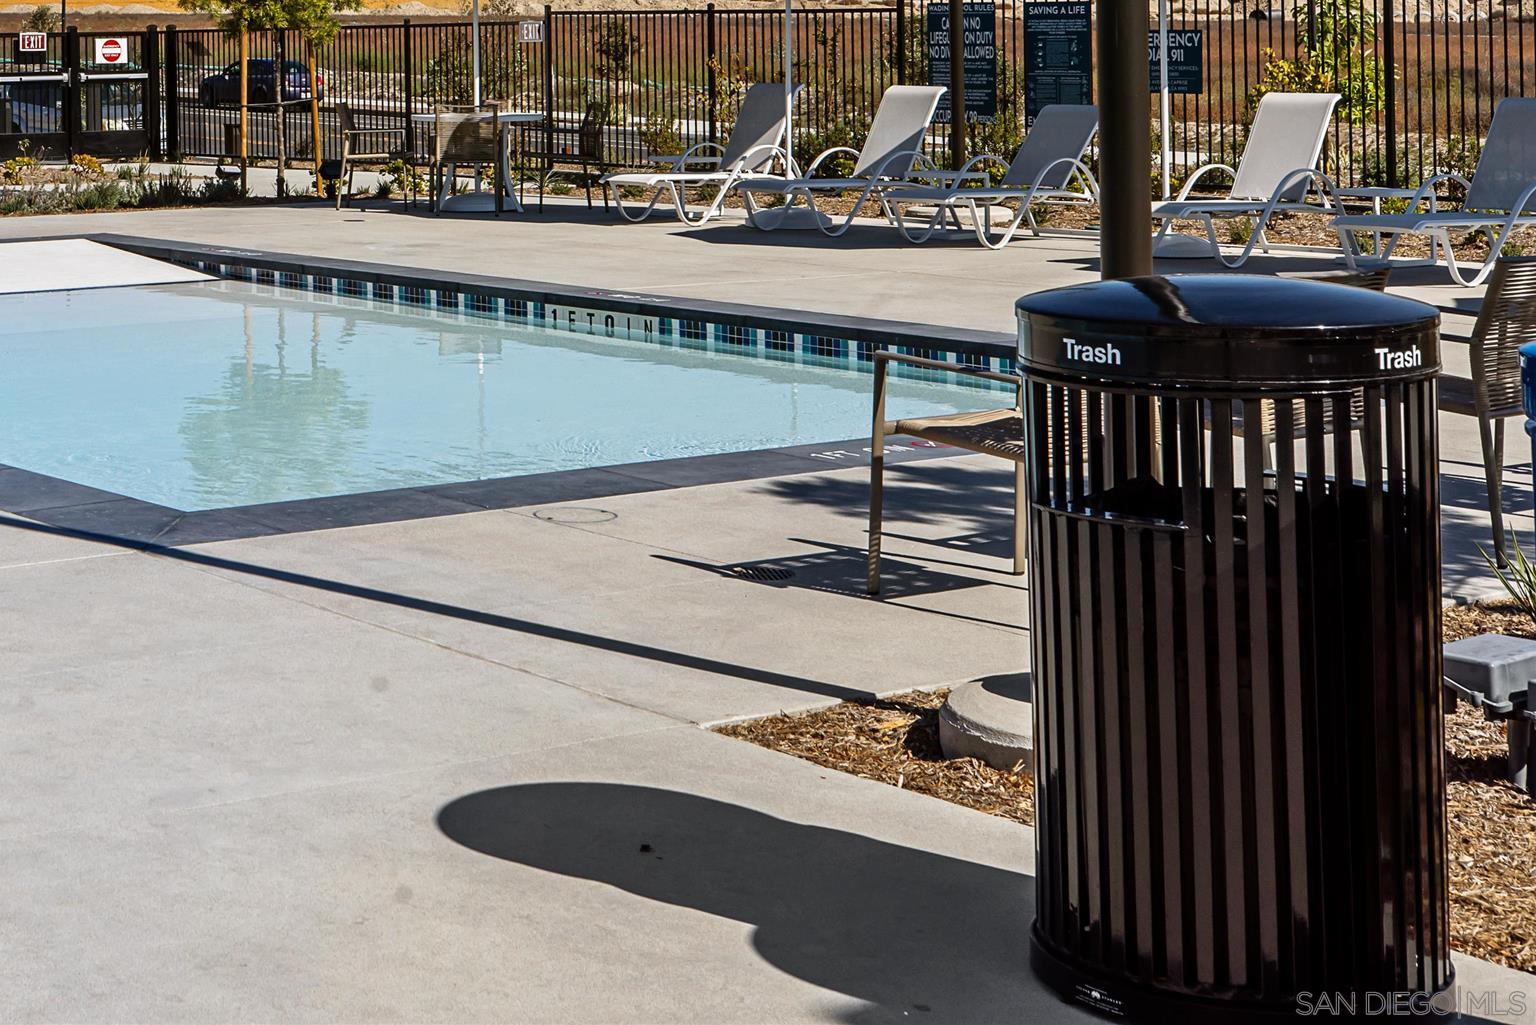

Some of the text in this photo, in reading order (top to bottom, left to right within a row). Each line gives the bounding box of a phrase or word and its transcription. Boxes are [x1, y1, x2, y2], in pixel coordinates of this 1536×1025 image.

[1028, 5, 1086, 15] SAVING A LIFE
[970, 16, 981, 30] NO
[524, 23, 540, 40] EXIT
[964, 31, 976, 44] ON
[976, 31, 994, 44] DUTY
[24, 35, 42, 49] EXIT
[1148, 32, 1201, 47] ERENCY
[929, 46, 940, 59] NO
[964, 46, 995, 59] ALLOWED
[1171, 48, 1184, 62] 911
[1062, 337, 1122, 365] Trash
[1374, 344, 1422, 370] Trash
